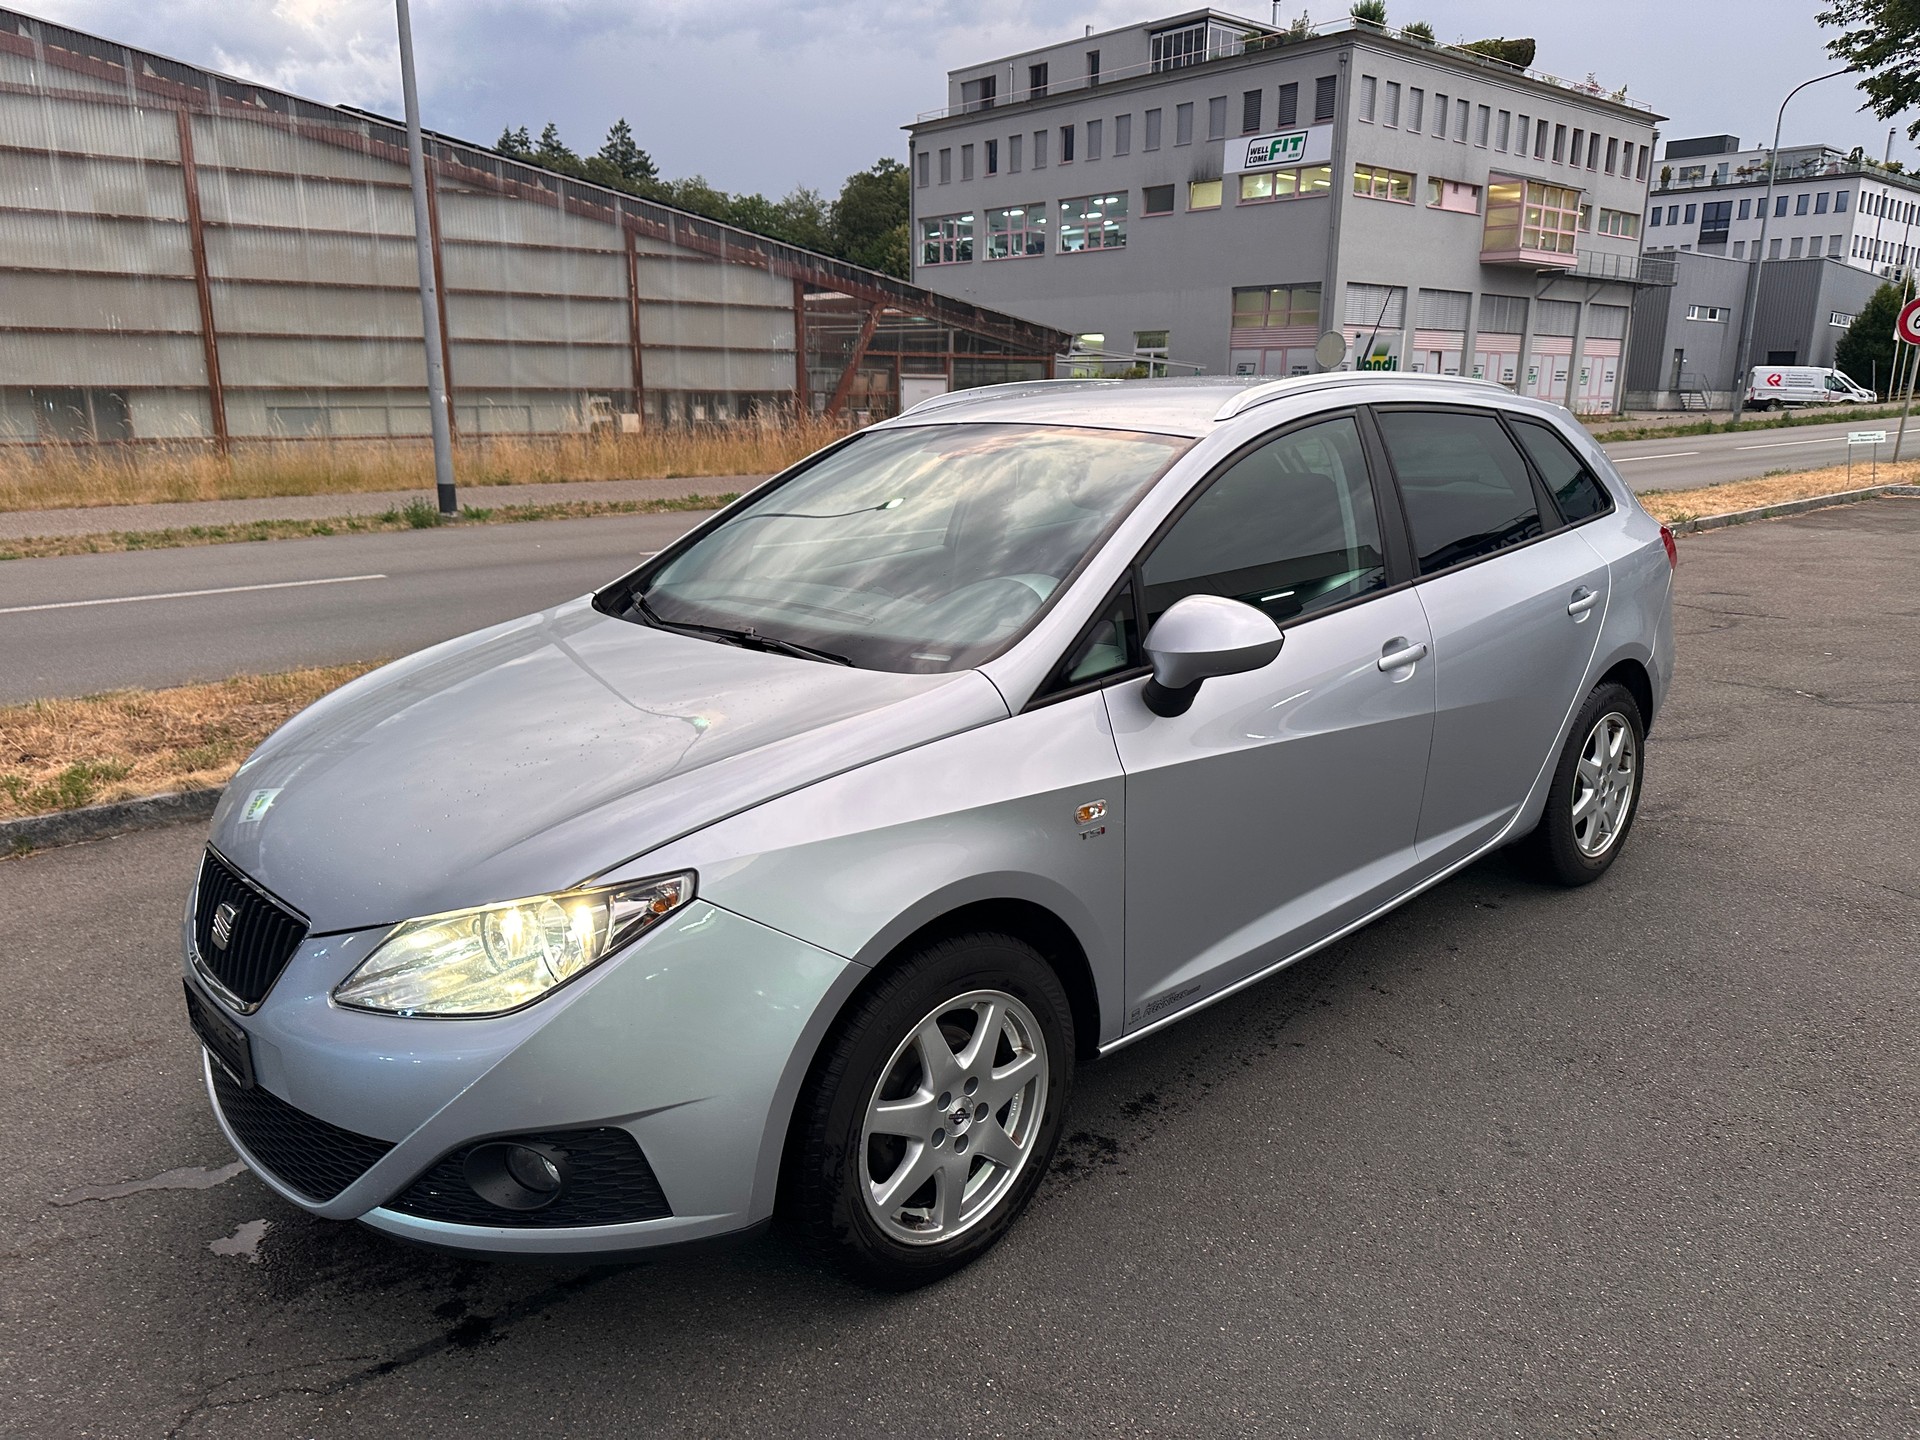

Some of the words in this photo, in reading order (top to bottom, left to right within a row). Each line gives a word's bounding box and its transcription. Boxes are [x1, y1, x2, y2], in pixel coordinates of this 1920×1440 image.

[1250, 146, 1269, 155] WELL
[1268, 136, 1303, 160] FIT
[1249, 154, 1268, 163] COME
